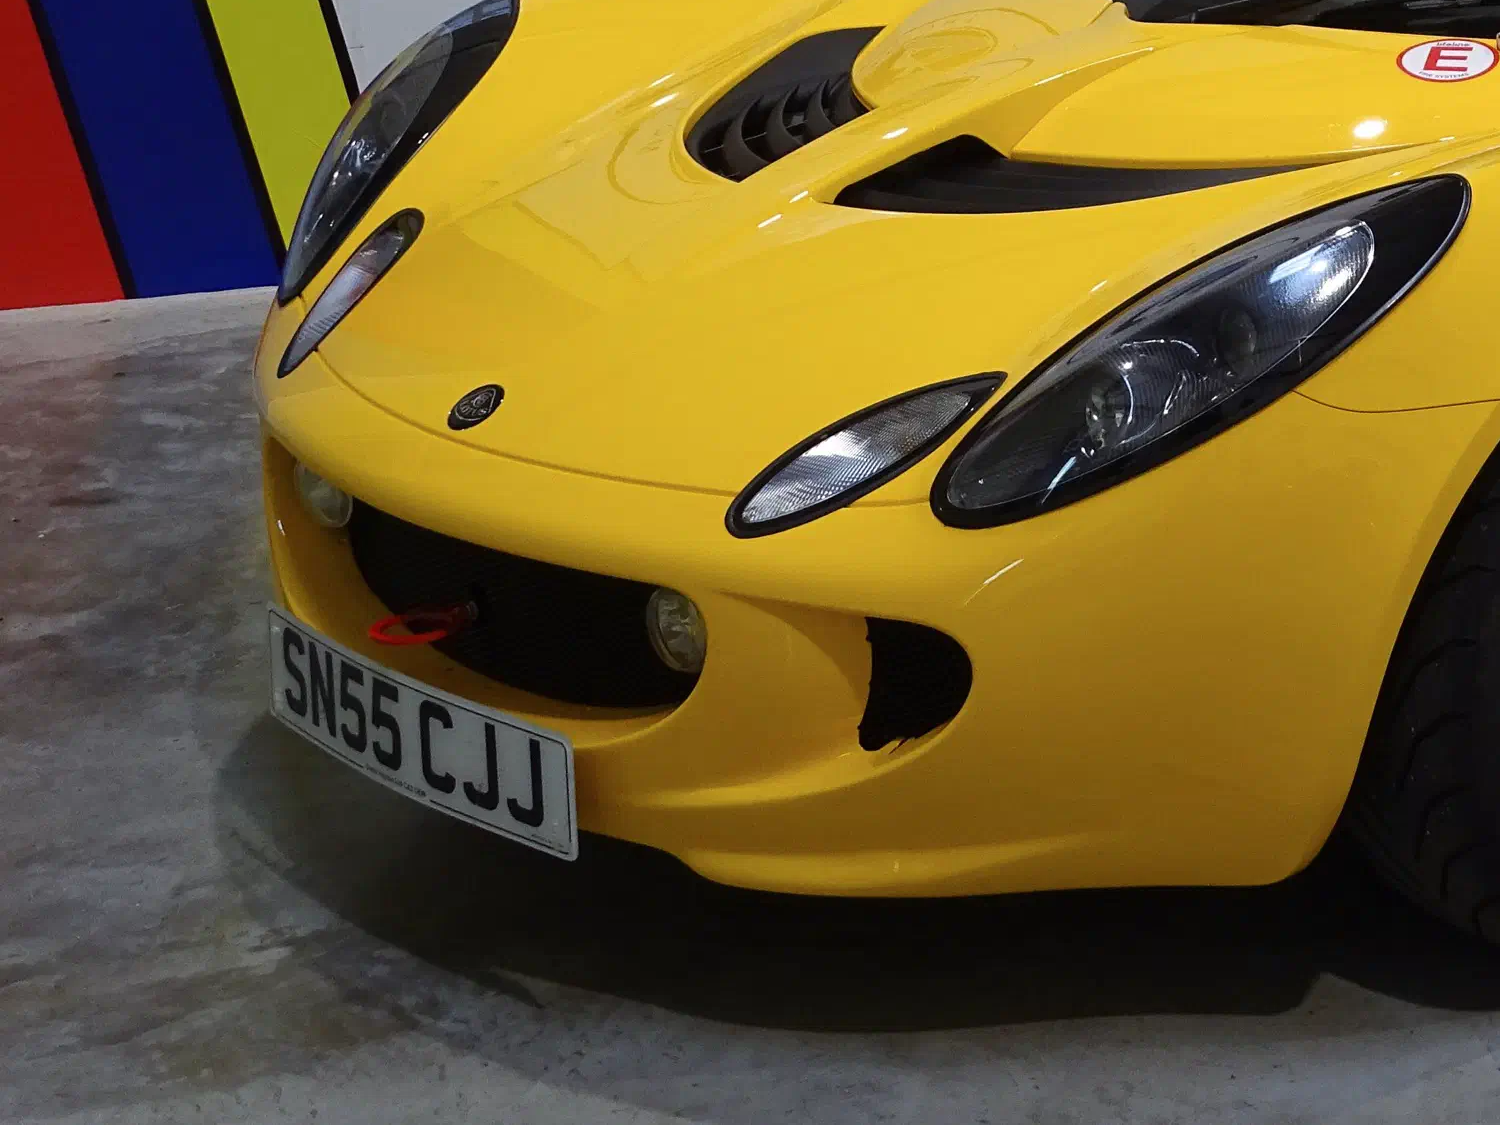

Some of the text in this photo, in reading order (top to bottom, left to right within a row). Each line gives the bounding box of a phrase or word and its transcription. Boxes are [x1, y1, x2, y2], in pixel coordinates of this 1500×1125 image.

[1423, 46, 1473, 71] E
[283, 627, 545, 828] SN55 CJJ
